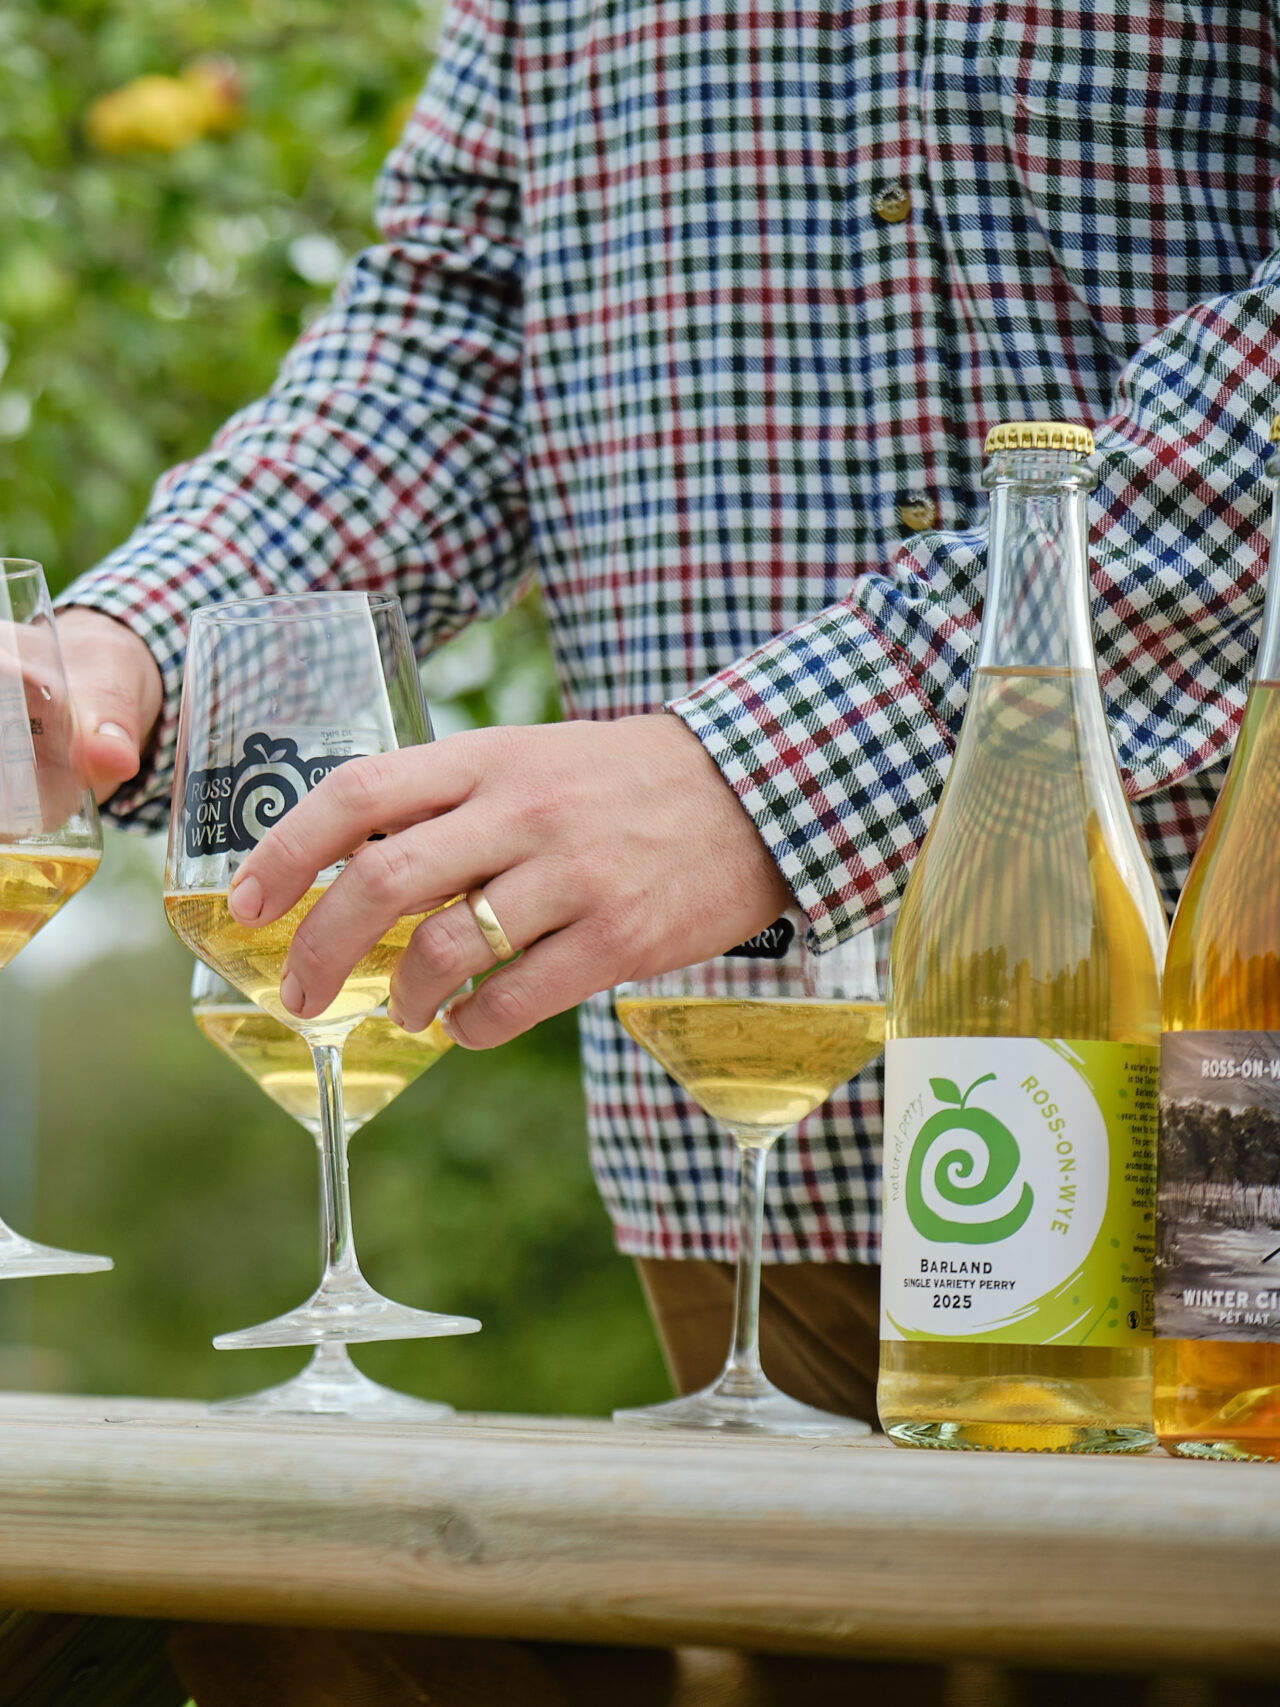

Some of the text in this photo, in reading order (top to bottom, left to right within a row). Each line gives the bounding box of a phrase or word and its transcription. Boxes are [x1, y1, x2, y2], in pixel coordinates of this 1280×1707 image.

[191, 777, 232, 802] ROSS
[197, 801, 221, 824] ON
[191, 823, 227, 847] WYE
[890, 1093, 924, 1200] natural perry
[1020, 1075, 1077, 1235] ROSS-ON-WYE
[904, 1278, 1016, 1290] SINGLE VARIETY PERRY
[933, 1294, 972, 1309] 2025
[1183, 1289, 1280, 1310] WINTER CI
[1244, 1311, 1270, 1325] NAT
